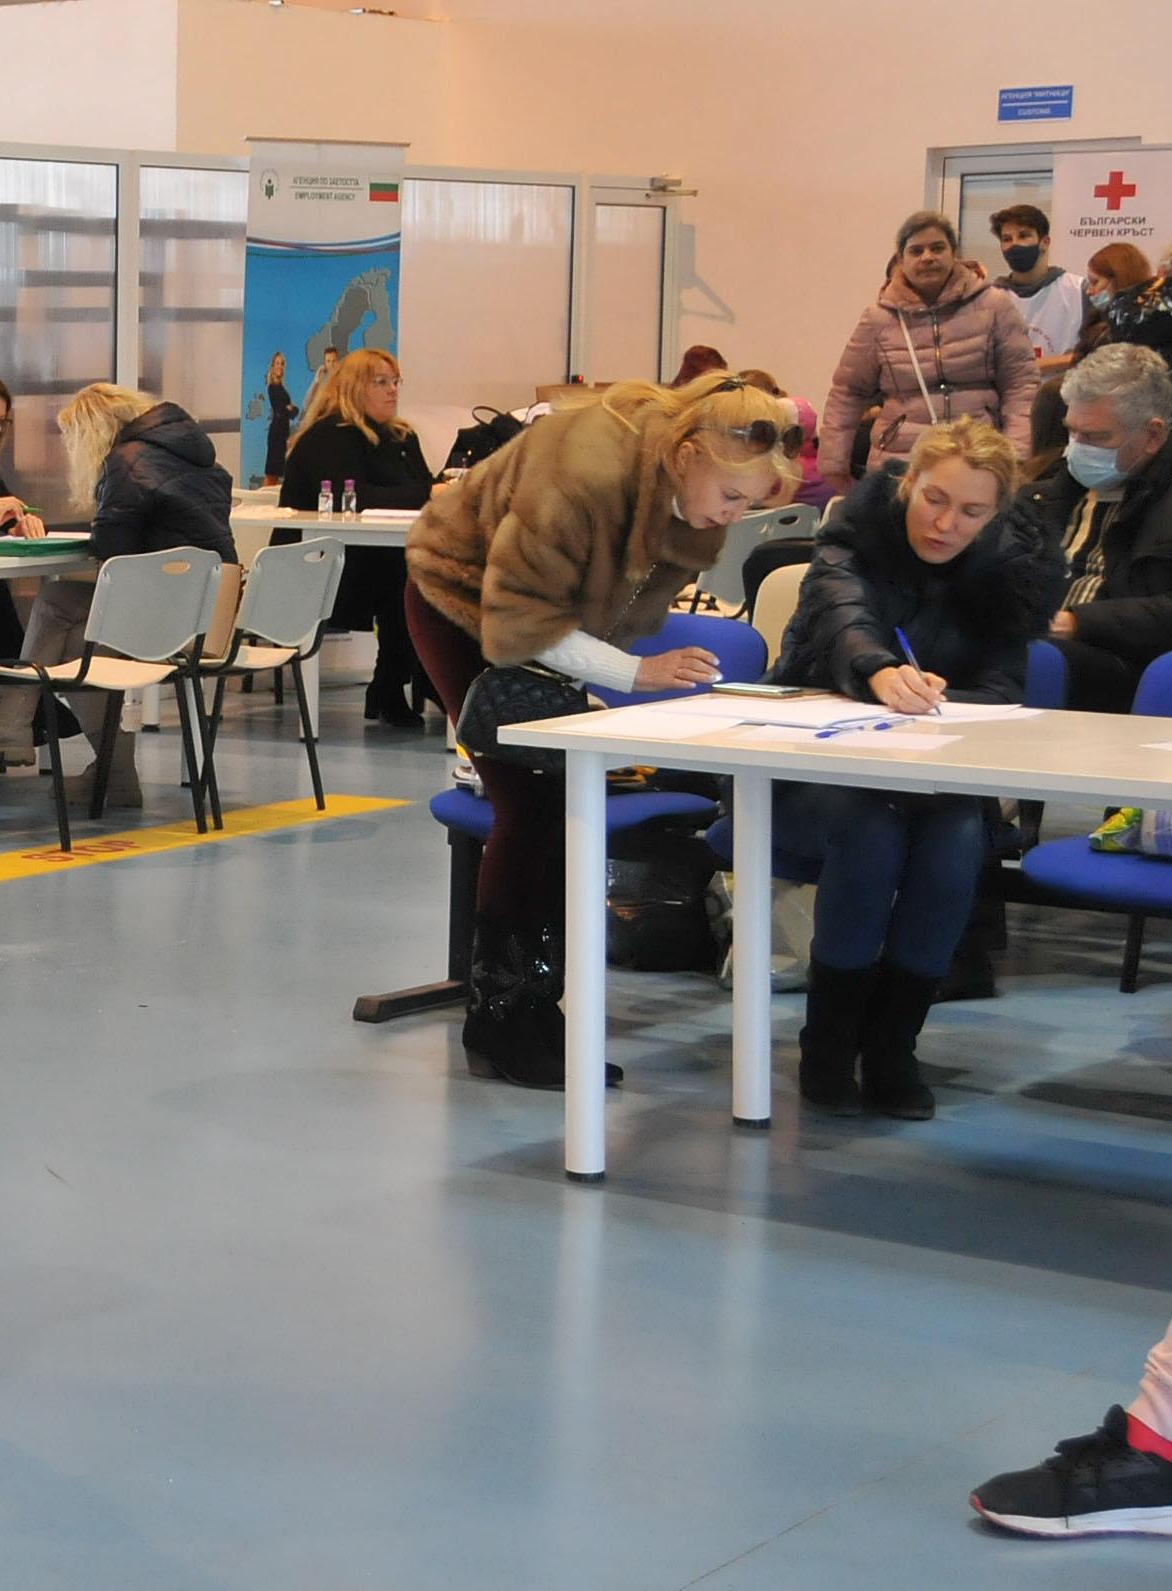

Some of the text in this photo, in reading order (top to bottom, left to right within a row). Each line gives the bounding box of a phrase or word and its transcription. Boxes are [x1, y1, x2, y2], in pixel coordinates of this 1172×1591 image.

[1018, 107, 1051, 115] CUSTOMS
[295, 192, 356, 201] EMPLOYMENT AGENCY
[1080, 216, 1146, 226] БЪЛГАРСКИ
[1069, 227, 1154, 237] ЧЕРВЕН КРЪСТ
[20, 840, 141, 862] STOP
